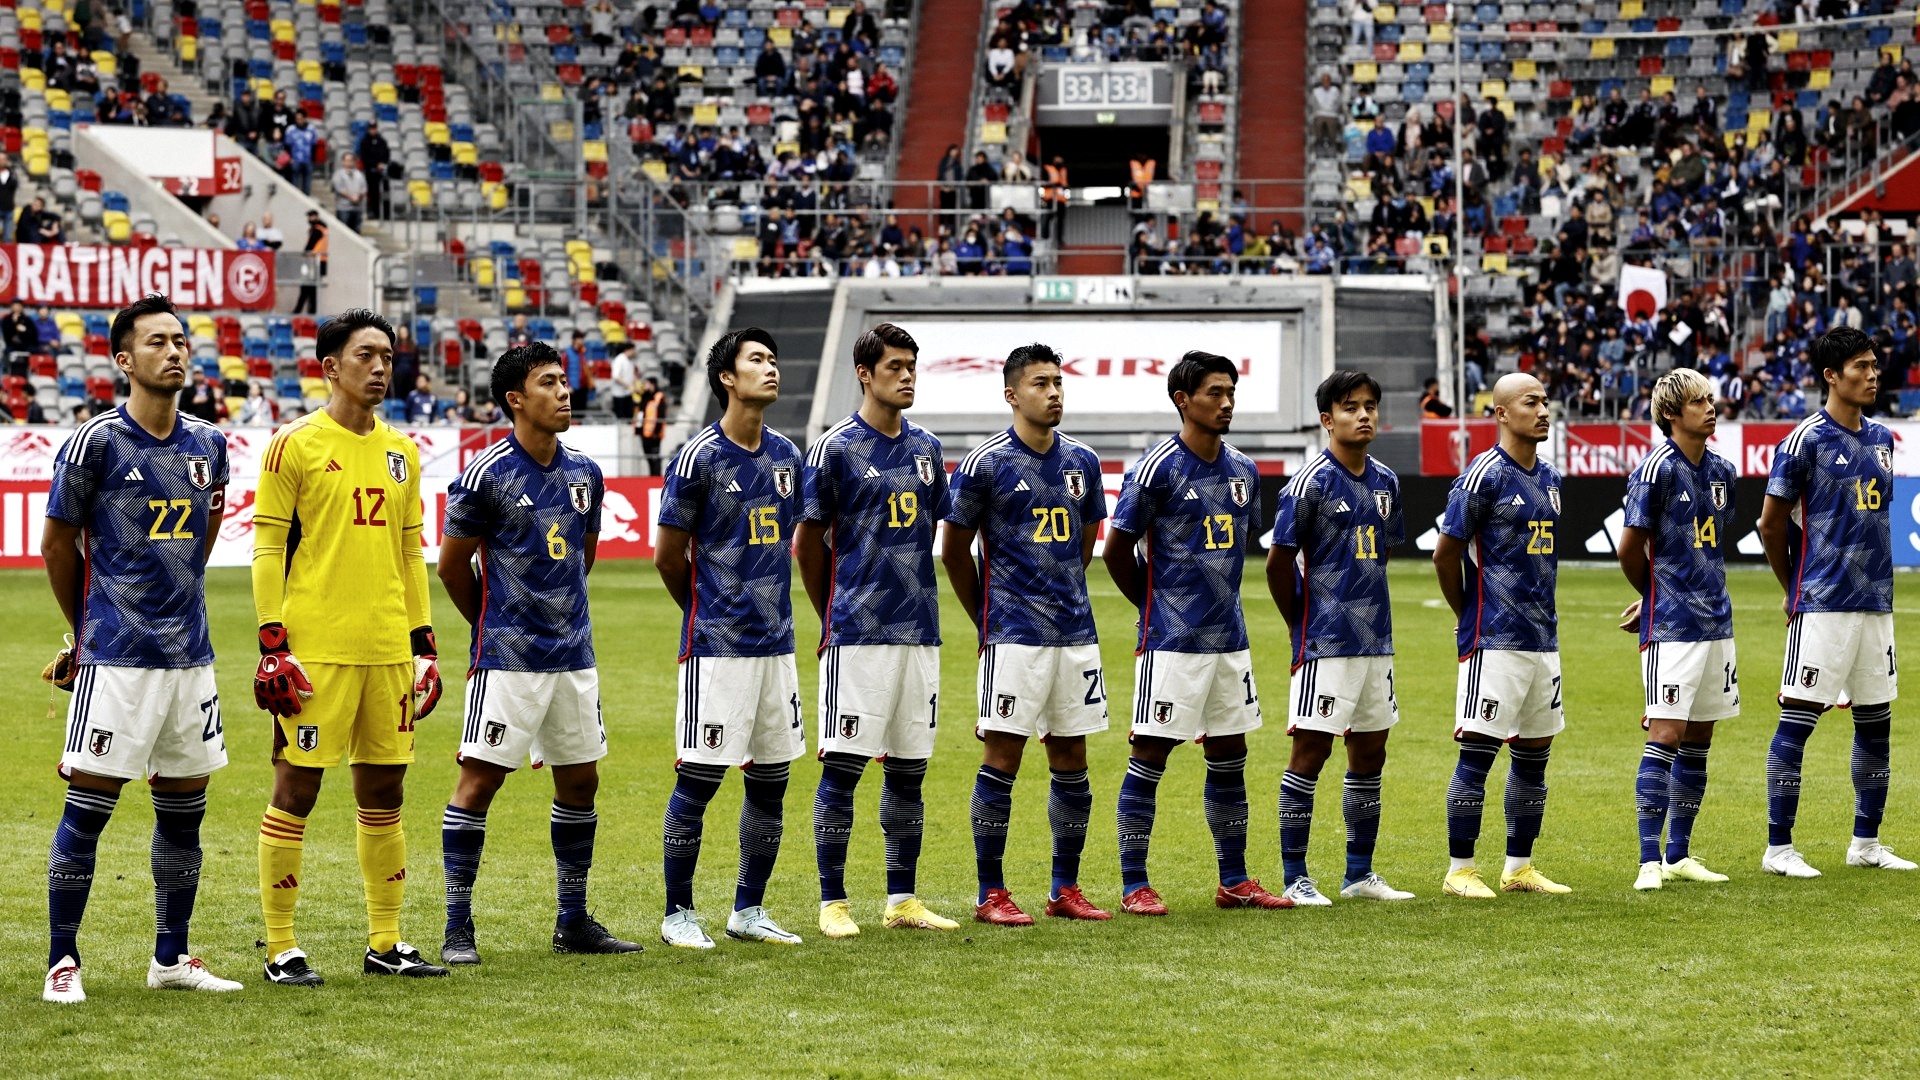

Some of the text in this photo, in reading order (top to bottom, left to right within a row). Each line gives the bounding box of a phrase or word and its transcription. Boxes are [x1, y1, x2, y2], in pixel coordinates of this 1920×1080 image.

[222, 162, 241, 190] 32
[17, 243, 224, 305] RATINGEN
[1570, 444, 1648, 475] KIRIN
[209, 490, 223, 511] C
[353, 488, 386, 526] 12
[887, 492, 917, 528] 19
[1855, 478, 1881, 511] 16
[149, 499, 194, 540] 22
[748, 507, 780, 545] 15
[1032, 507, 1071, 542] 20
[1203, 514, 1234, 549] 13
[1693, 515, 1717, 549] 14
[546, 523, 567, 560] 6
[1355, 525, 1378, 560] 11
[1527, 521, 1554, 555] 25
[1551, 675, 1561, 710] 2
[790, 692, 802, 729] 1
[930, 693, 937, 729] 1
[819, 826, 852, 834] JAPA
[975, 819, 1008, 828] JAPA
[1122, 833, 1150, 841] JAPA
